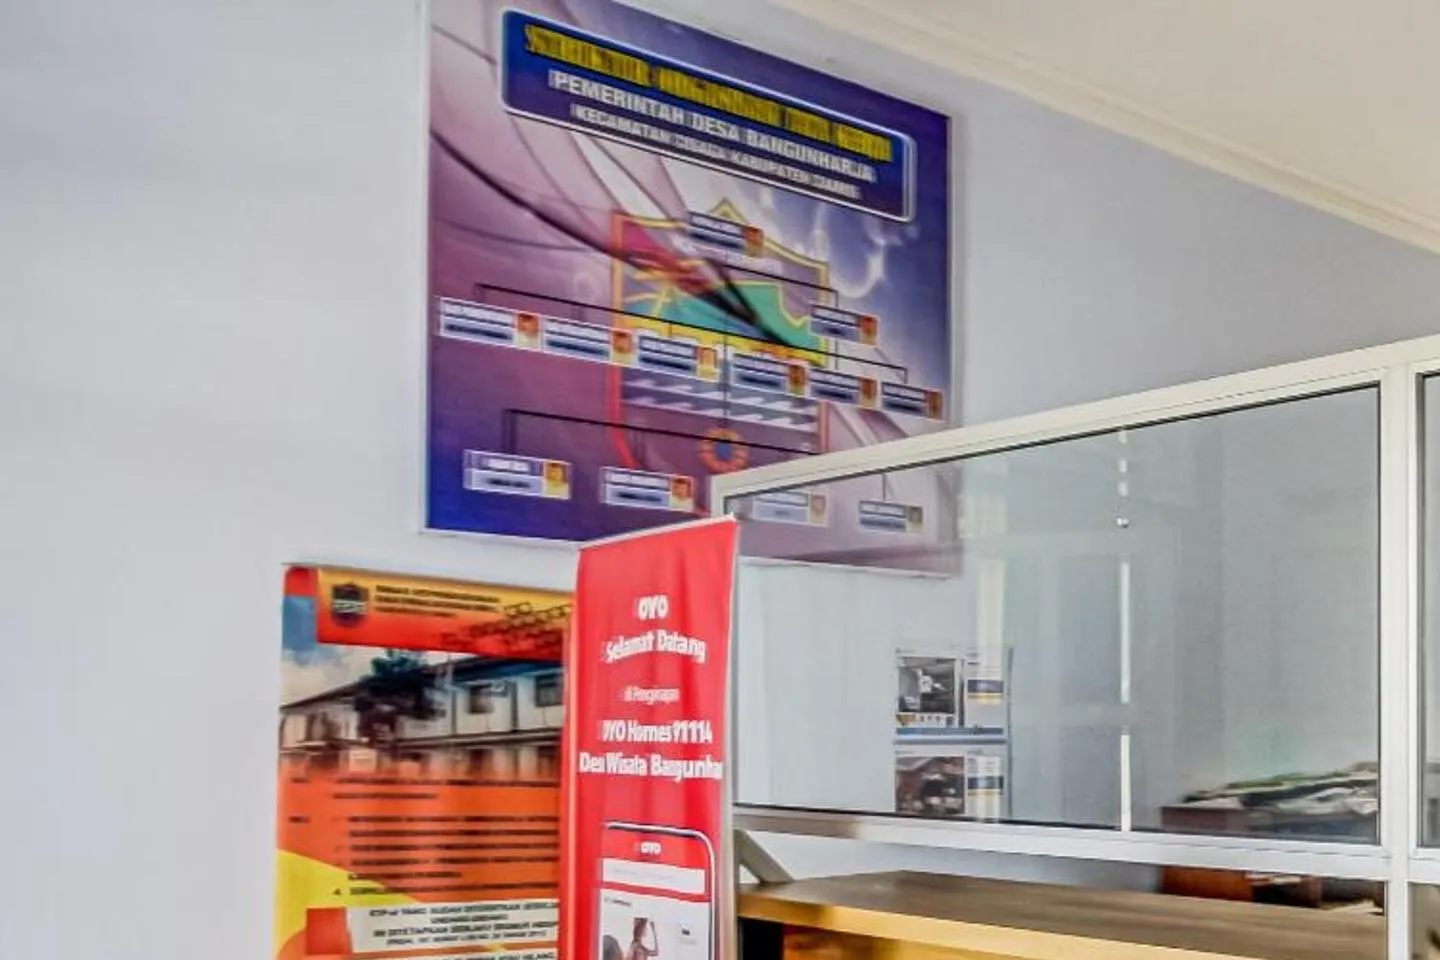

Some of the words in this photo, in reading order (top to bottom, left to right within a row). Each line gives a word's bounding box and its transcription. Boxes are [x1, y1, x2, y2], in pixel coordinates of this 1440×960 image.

[550, 69, 685, 123] PEMERINTAH
[692, 111, 739, 138] DESA
[638, 595, 669, 620] OYO
[606, 631, 655, 663] Selamat
[657, 629, 706, 663] Datang
